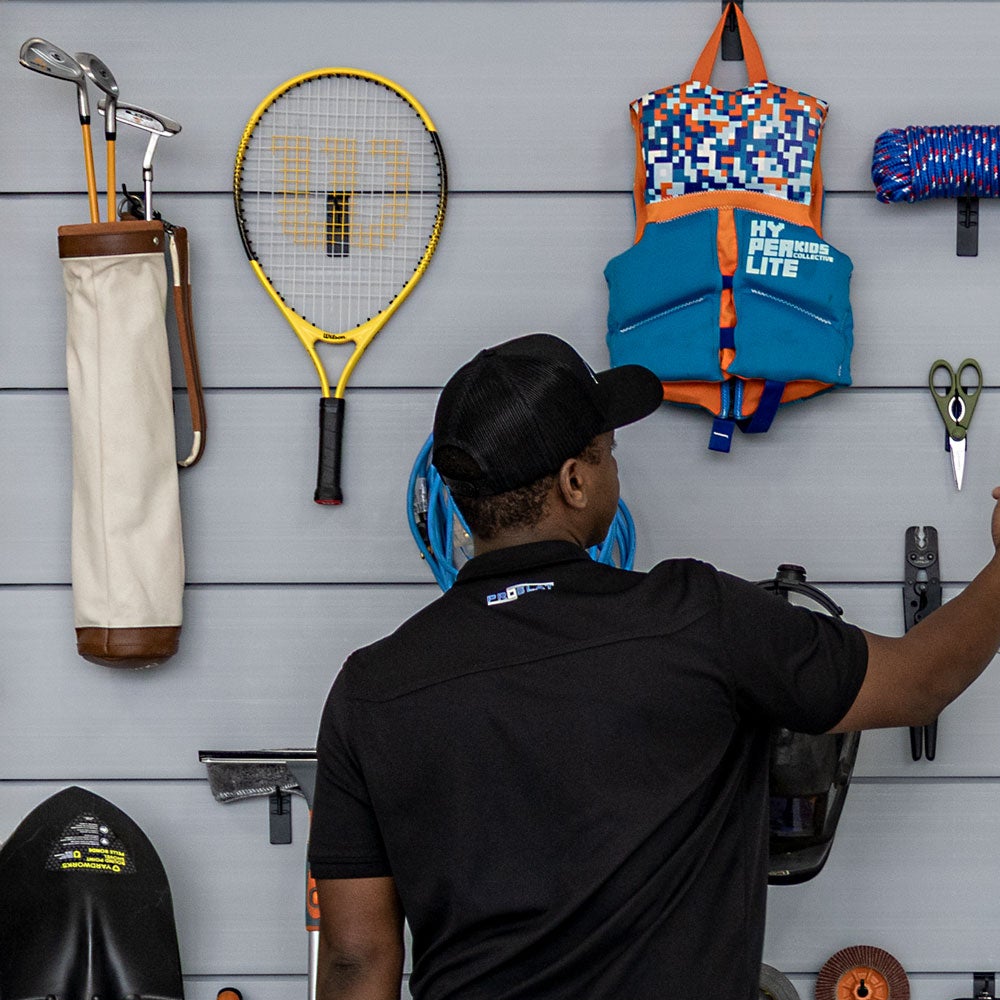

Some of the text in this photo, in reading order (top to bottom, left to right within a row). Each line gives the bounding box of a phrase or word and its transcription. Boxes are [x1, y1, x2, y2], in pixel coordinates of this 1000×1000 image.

[750, 220, 785, 238] HY
[748, 237, 830, 258] PER KIDS
[793, 252, 834, 263] COLLECTIVE
[746, 256, 799, 278] LITE
[61, 861, 112, 870] YARDWORKS
